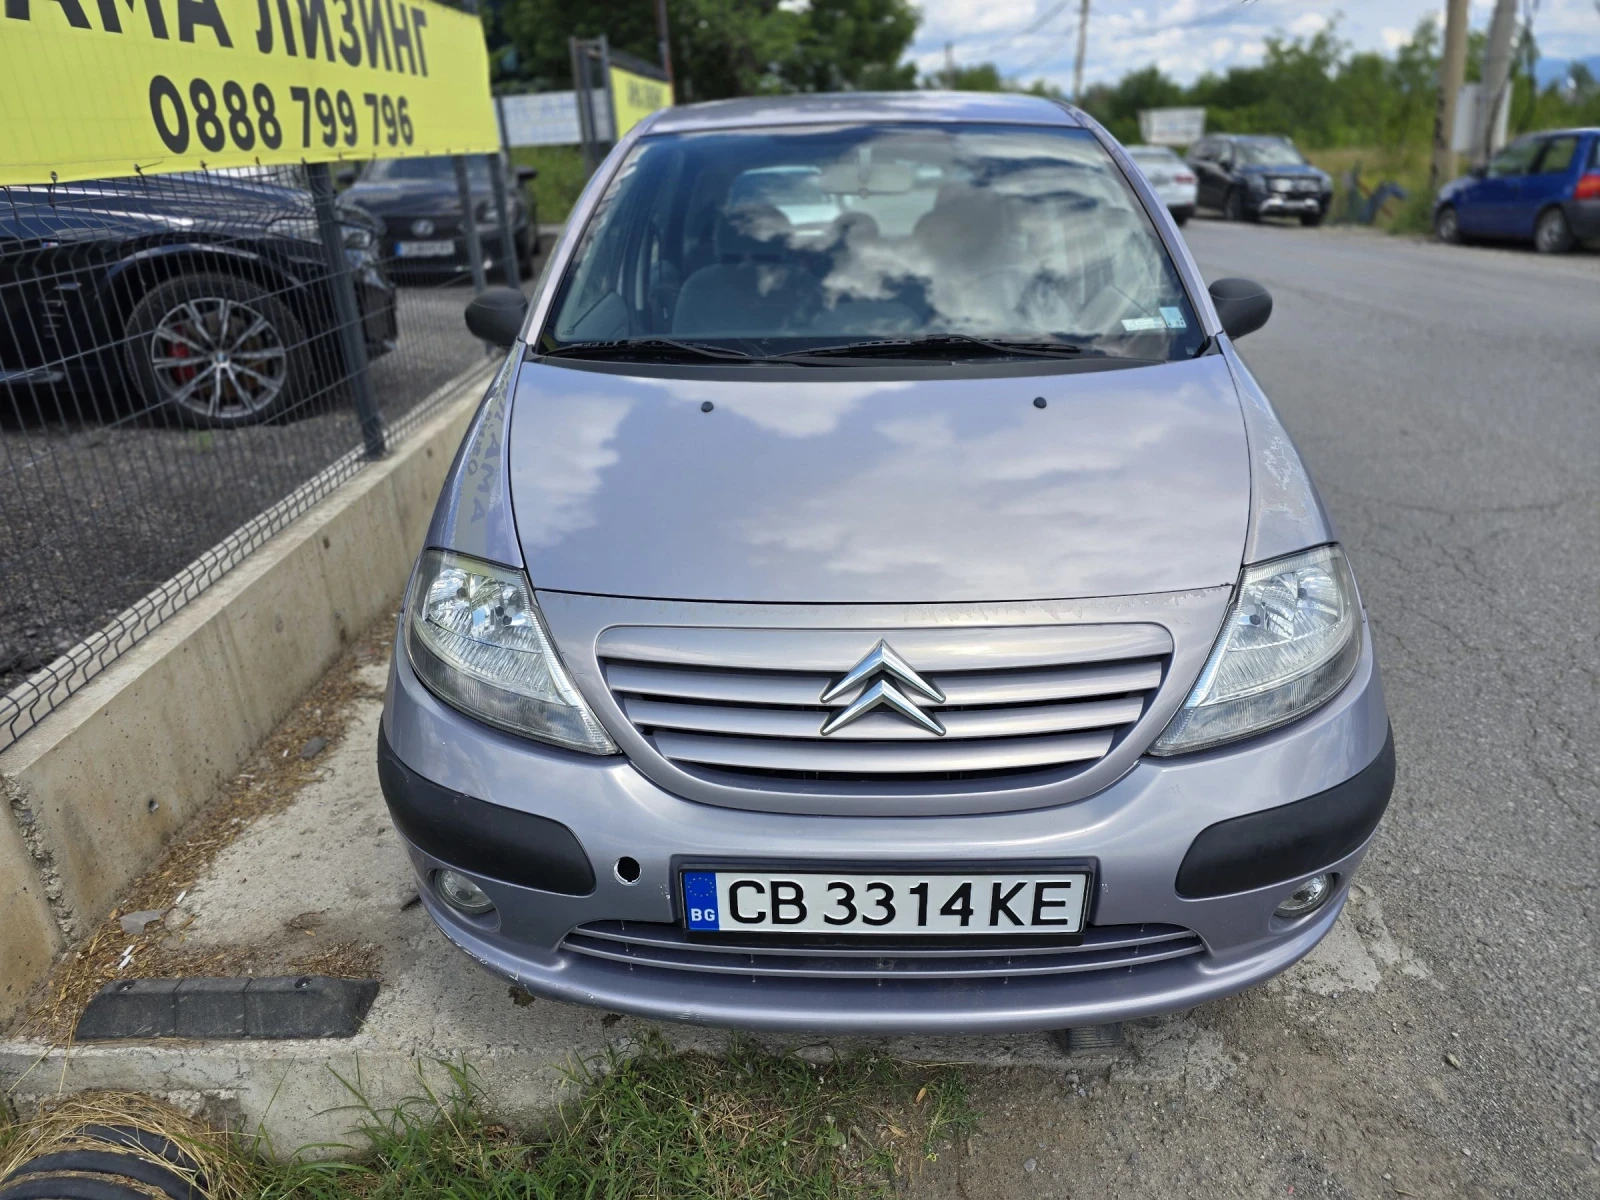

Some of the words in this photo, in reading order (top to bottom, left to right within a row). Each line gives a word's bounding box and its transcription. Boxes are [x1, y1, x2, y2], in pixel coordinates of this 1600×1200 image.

[256, 0, 428, 77] ЛИЗИНГ
[149, 74, 283, 154] 0888
[290, 86, 358, 148] 799
[363, 92, 414, 147] 796
[691, 908, 715, 922] BG
[729, 880, 808, 924] CB
[823, 881, 974, 927] 3314
[989, 881, 1072, 926] KE
